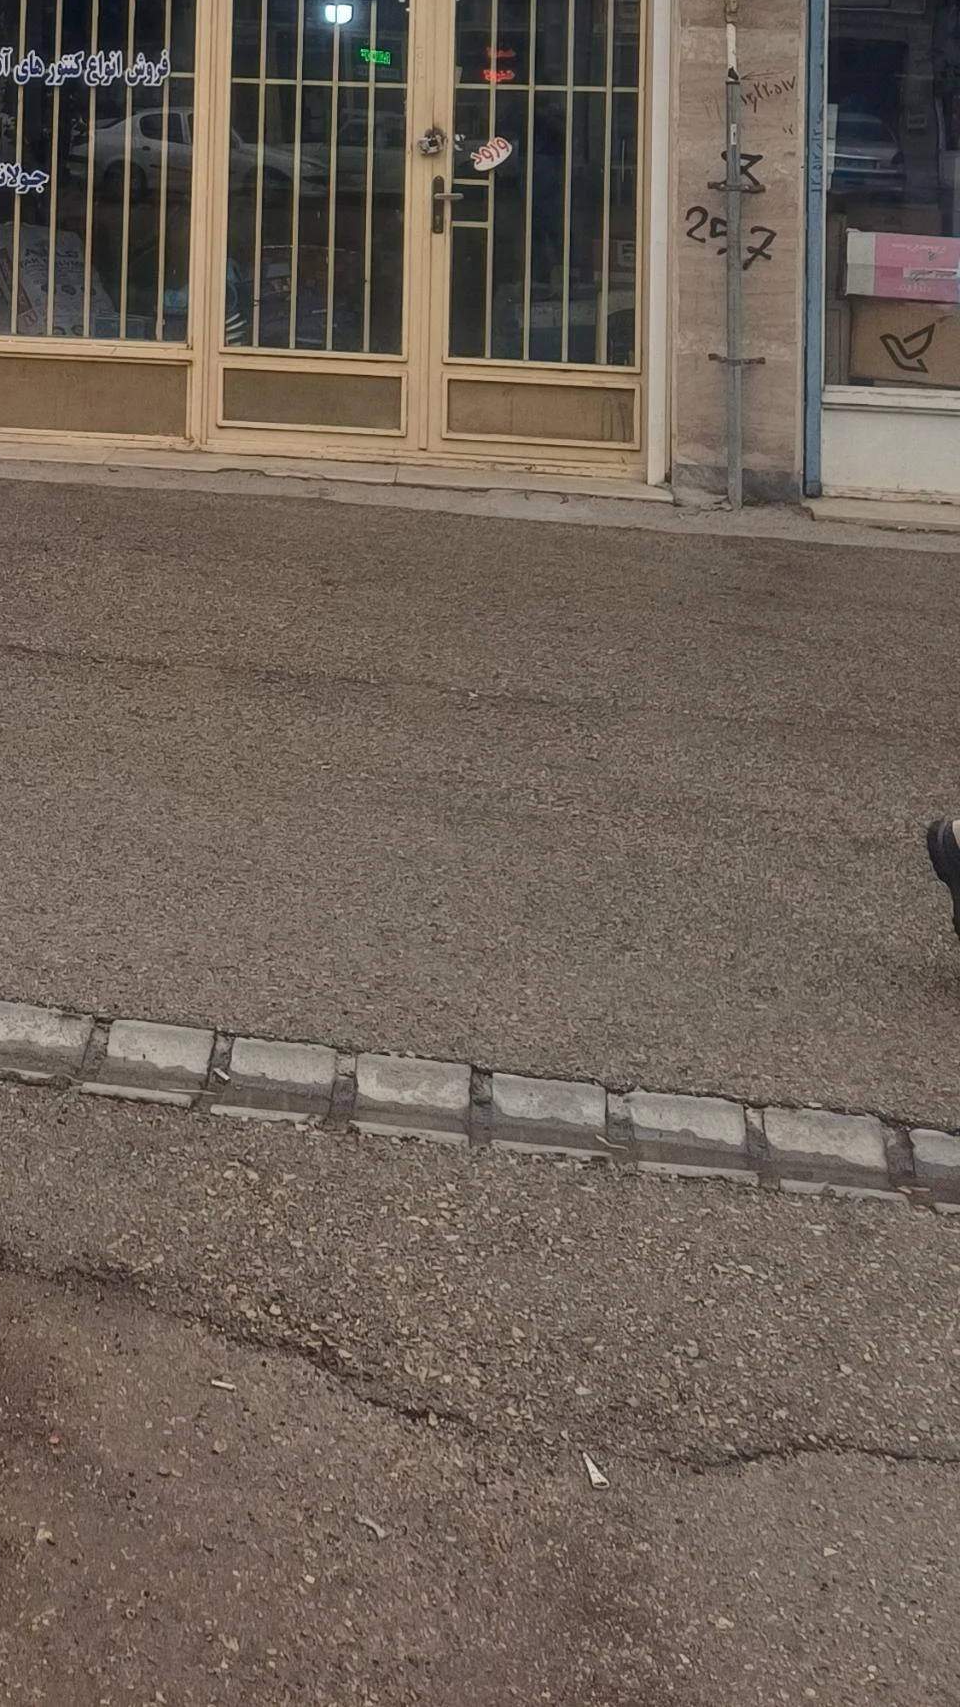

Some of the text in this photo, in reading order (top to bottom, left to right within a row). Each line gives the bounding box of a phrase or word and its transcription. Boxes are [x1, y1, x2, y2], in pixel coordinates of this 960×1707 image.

[13, 50, 44, 85] های
[45, 50, 85, 85] کنتور
[84, 50, 123, 86] انواع
[125, 49, 171, 86] فروش
[471, 138, 511, 166] ورود
